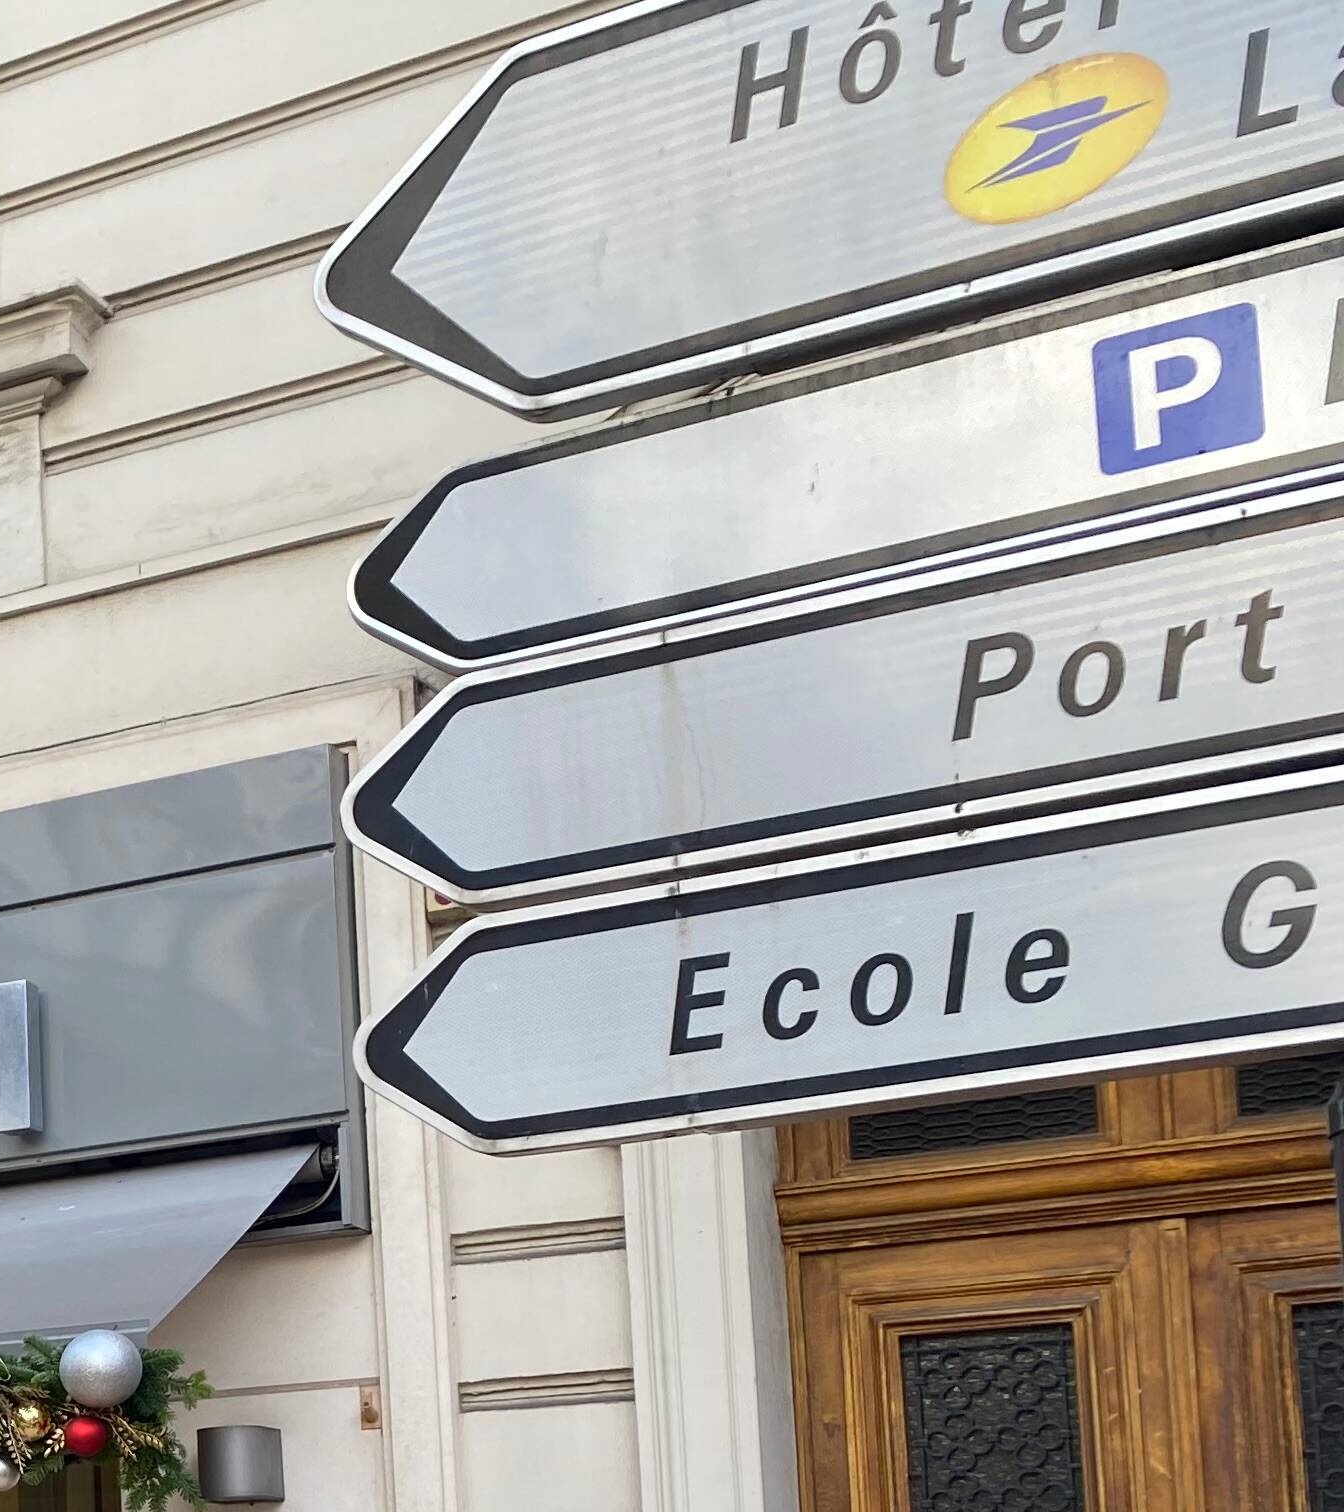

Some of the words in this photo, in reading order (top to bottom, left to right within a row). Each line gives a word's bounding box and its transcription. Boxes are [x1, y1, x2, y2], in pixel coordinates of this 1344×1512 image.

[1236, 27, 1344, 138] L
[952, 589, 1284, 742] Port
[669, 910, 1070, 1056] Ecole
